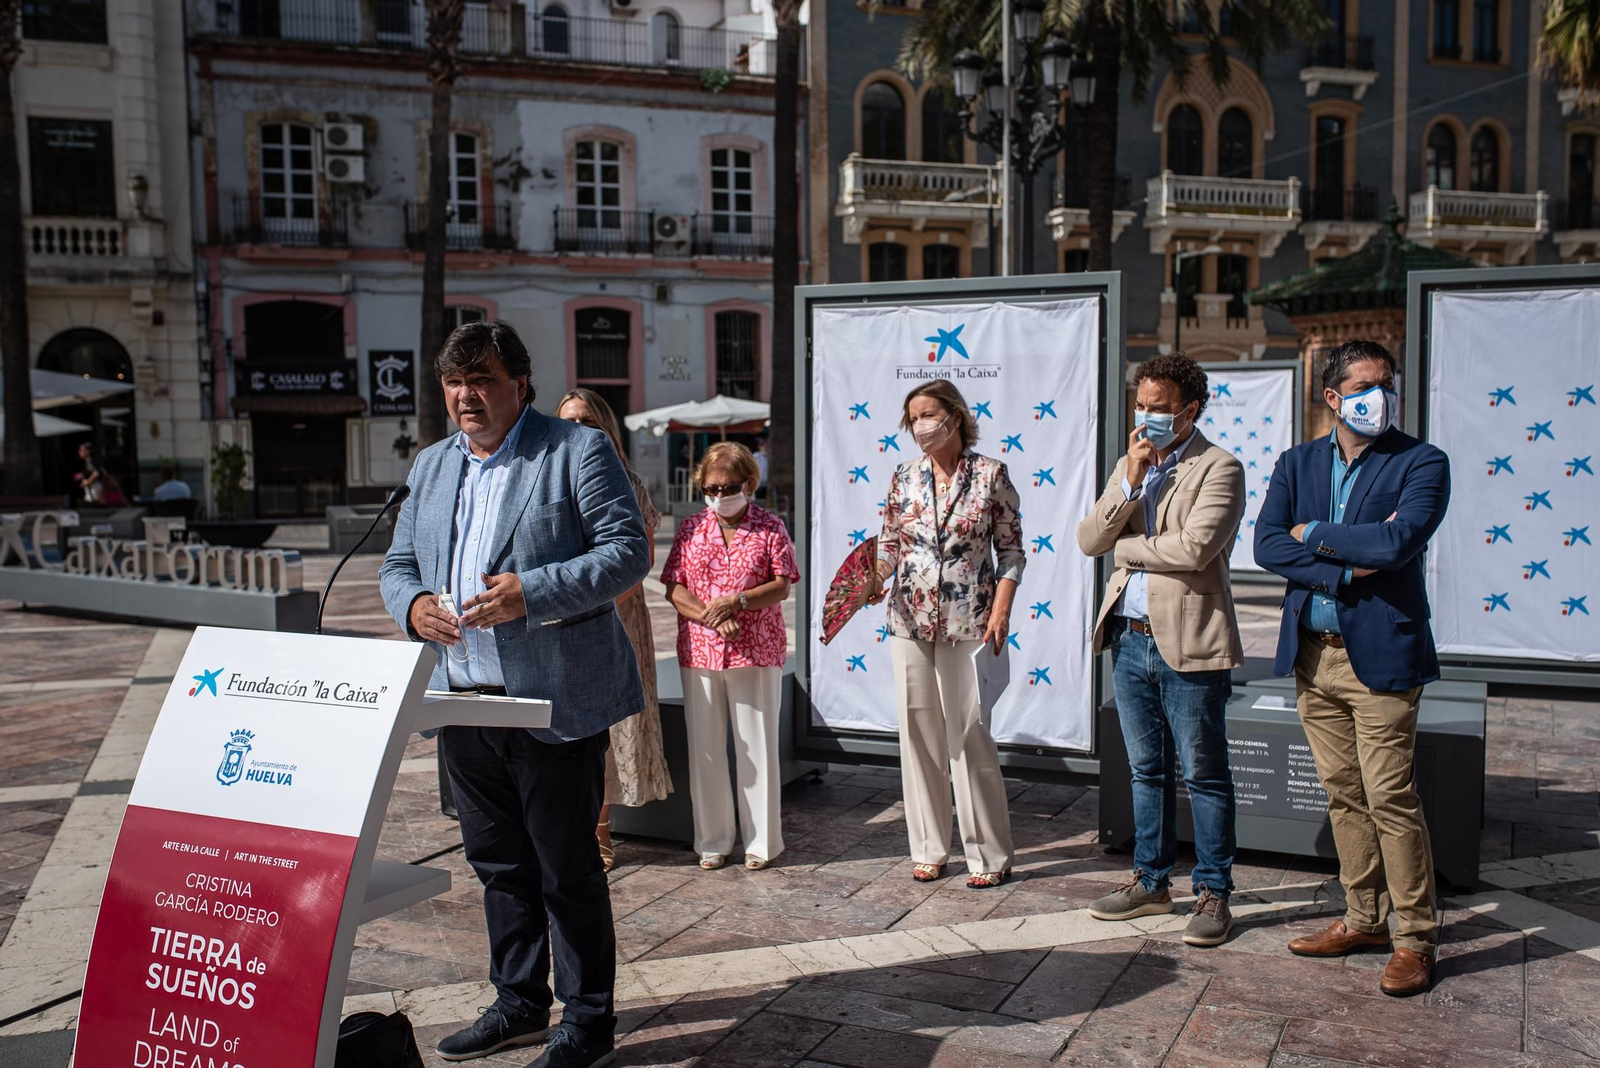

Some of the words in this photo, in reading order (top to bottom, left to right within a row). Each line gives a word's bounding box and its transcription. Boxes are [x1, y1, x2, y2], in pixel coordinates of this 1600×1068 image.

[896, 368, 951, 380] Fundación
[953, 367, 966, 379] "la
[967, 366, 1001, 379] Caixa"
[227, 673, 308, 697] Fundación
[333, 682, 387, 704] Caixa"
[1244, 740, 1269, 748] GENERAL
[250, 759, 288, 771] Ayuntamiento
[245, 769, 292, 786] HUELVA
[163, 840, 180, 851] ARTE
[180, 842, 190, 852] EN
[190, 844, 199, 854] LA
[200, 846, 220, 857] CALLE
[234, 851, 249, 862] ART
[249, 853, 258, 863] IN
[259, 855, 272, 866] THE
[273, 857, 299, 870] STREET
[186, 872, 252, 898] CRISTINA
[155, 891, 209, 915] GARCÍA
[213, 901, 279, 927] RODERO
[150, 926, 242, 971] TIERRA
[246, 957, 266, 975] de
[145, 962, 257, 1009] SUEÑOS
[149, 1007, 220, 1048] LAND
[223, 1037, 240, 1053] of
